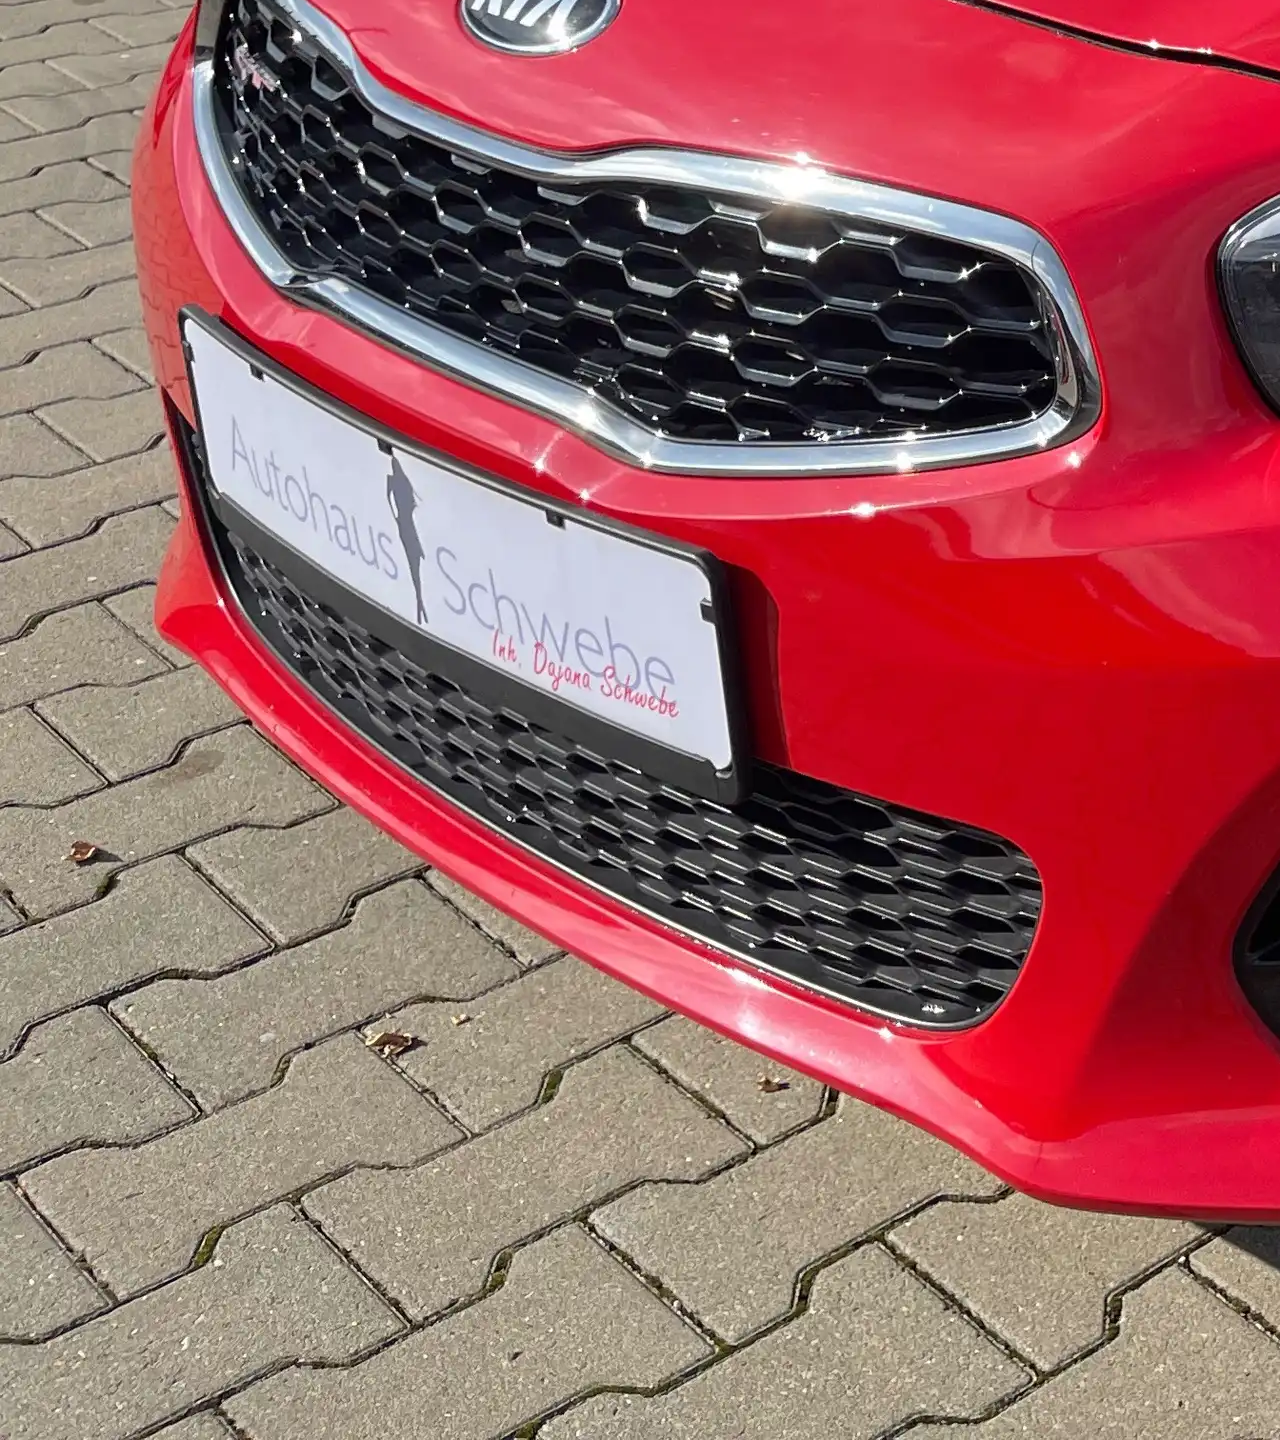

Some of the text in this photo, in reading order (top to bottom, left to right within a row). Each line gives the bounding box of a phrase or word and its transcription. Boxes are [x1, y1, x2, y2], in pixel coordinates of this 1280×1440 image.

[230, 413, 677, 705] Autohaus Schwebe
[533, 640, 592, 692] Dajana
[600, 665, 680, 718] Schwebe
